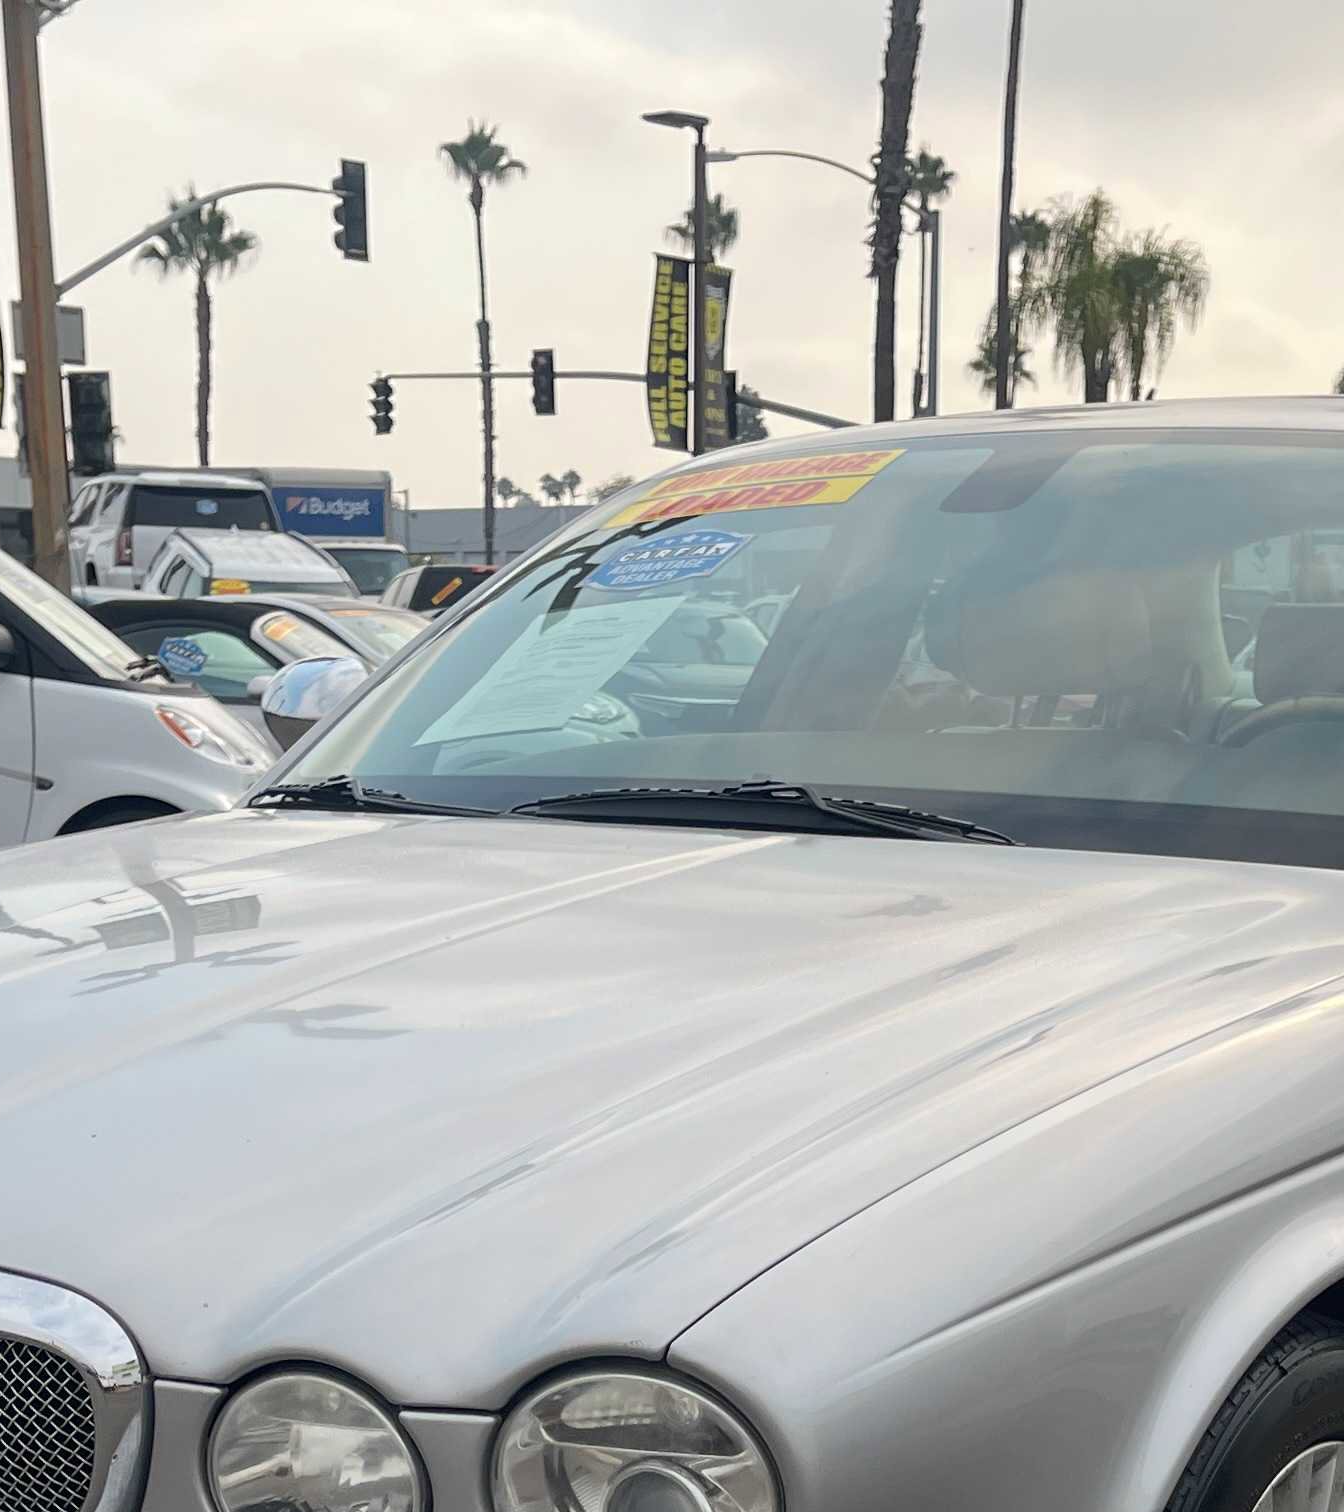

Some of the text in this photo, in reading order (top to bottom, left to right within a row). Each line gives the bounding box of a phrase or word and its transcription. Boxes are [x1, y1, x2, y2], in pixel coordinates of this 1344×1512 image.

[649, 260, 673, 442] FULL SERVICE
[668, 281, 688, 428] AUTO CARE
[308, 497, 371, 520] Budget
[632, 480, 831, 521] LOADED
[618, 543, 735, 563] CARFAX
[607, 557, 706, 575] ADVANTAGE
[610, 570, 679, 585] DEALER
